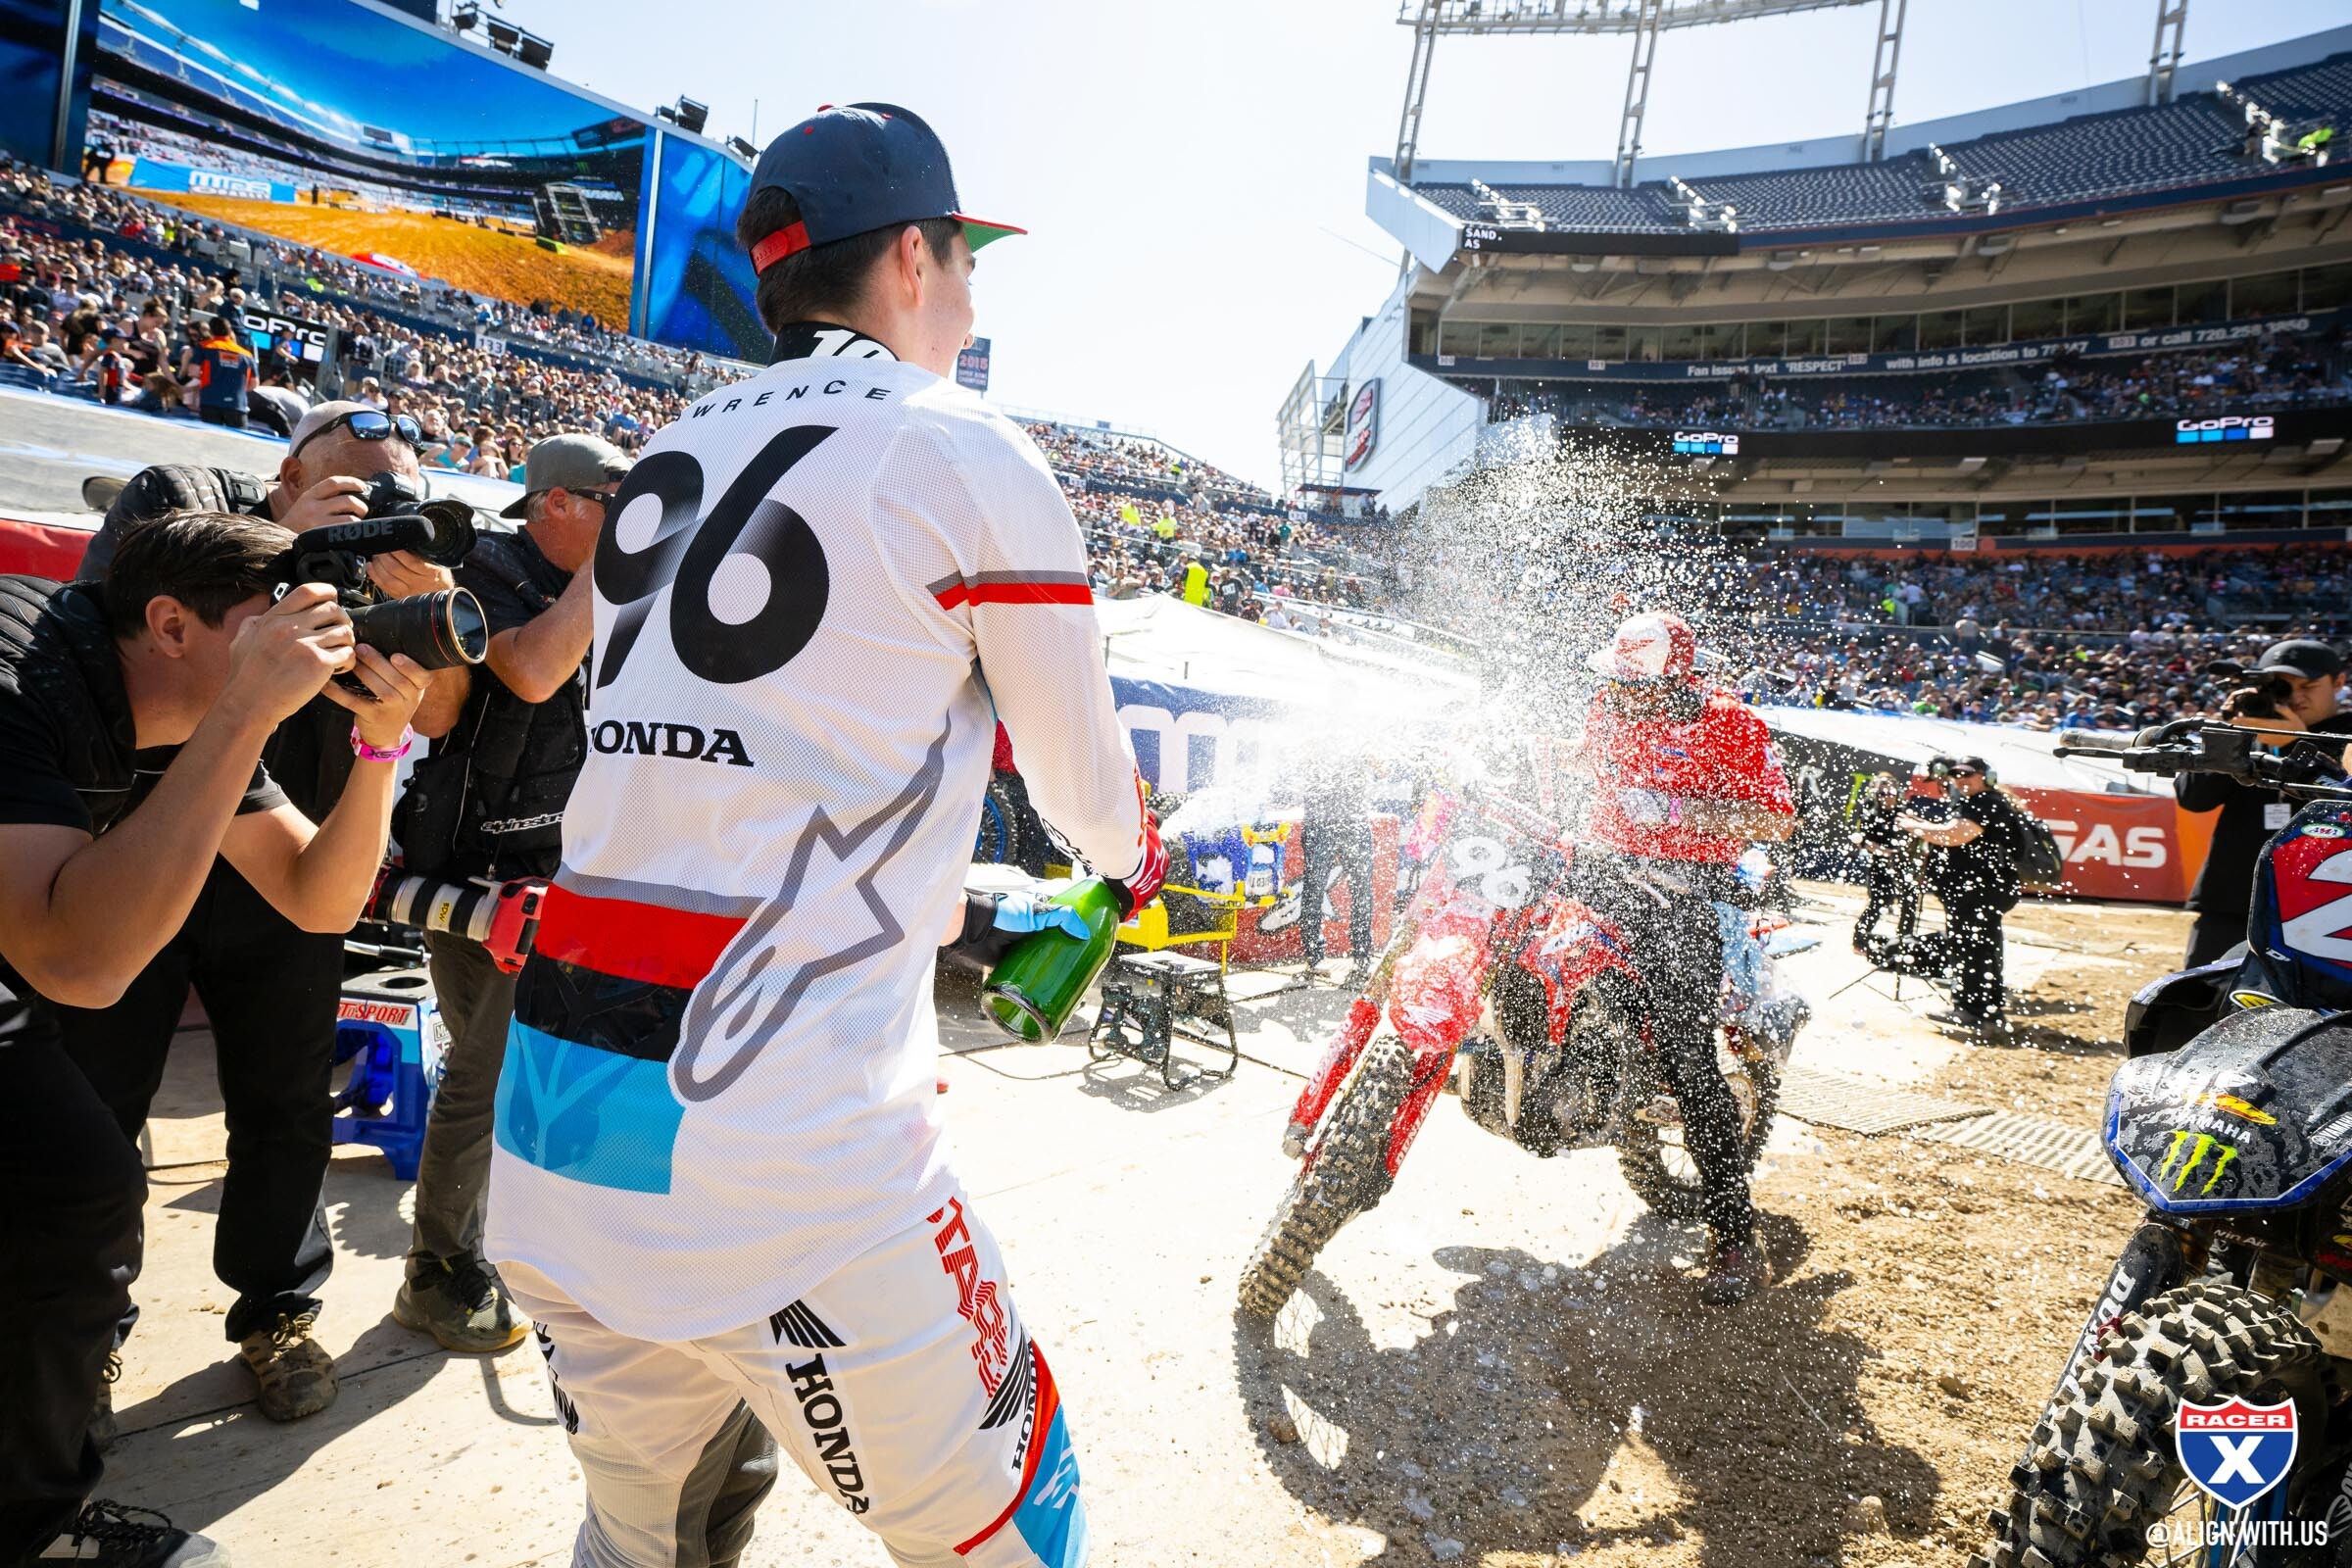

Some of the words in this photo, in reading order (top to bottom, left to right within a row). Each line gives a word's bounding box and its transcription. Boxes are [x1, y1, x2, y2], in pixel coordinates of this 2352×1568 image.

[1464, 238, 1481, 249] AS
[244, 314, 327, 347] oPro
[1688, 366, 1709, 377] Fan
[1886, 357, 1915, 369] with
[1917, 355, 1944, 368] info
[1946, 353, 1958, 366] &
[1961, 345, 2019, 364] location
[2022, 346, 2038, 359] to
[2140, 334, 2159, 347] or
[2161, 330, 2191, 345] call
[675, 379, 892, 421] WRENCE
[1674, 431, 1740, 444] GoPro
[2177, 416, 2275, 432] GoPro
[594, 424, 841, 690] 96
[589, 719, 755, 768] ONDA
[785, 1352, 870, 1515] HONDA
